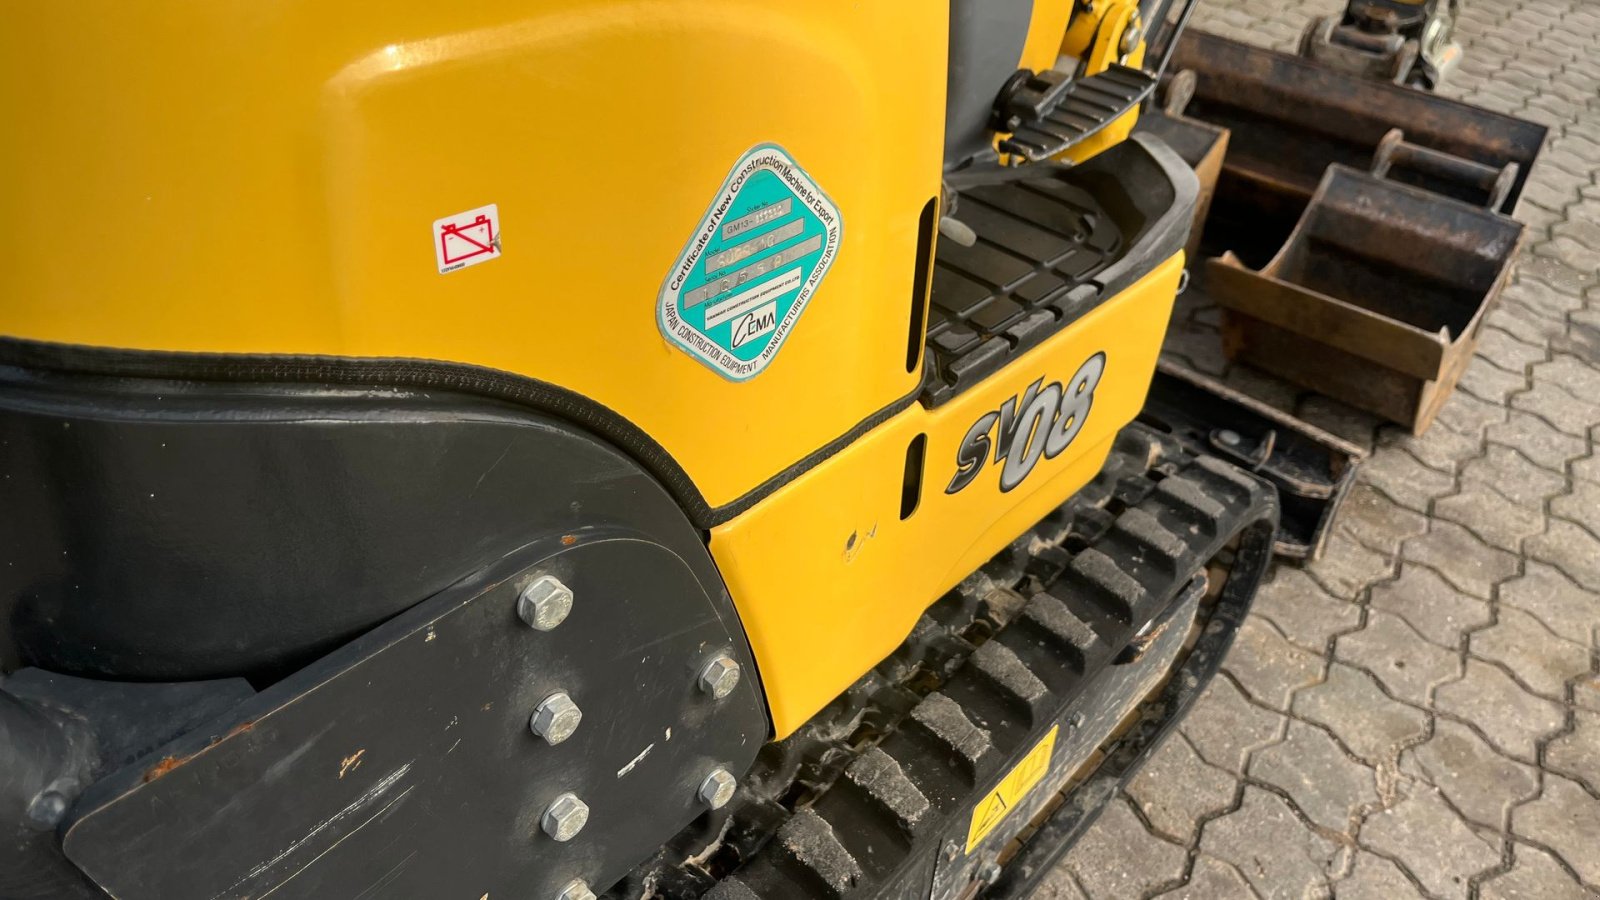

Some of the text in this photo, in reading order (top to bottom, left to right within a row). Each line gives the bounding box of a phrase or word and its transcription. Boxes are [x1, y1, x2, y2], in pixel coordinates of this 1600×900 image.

[670, 155, 834, 291] Certificate of New Construction Machine for Export
[665, 226, 837, 374] JAPAN CONSTRUCTION EQUIPMENT MANUFACTURERS ASSOCIATION
[726, 293, 760, 313] CONSTRUCTION
[944, 350, 1107, 495] SV08
